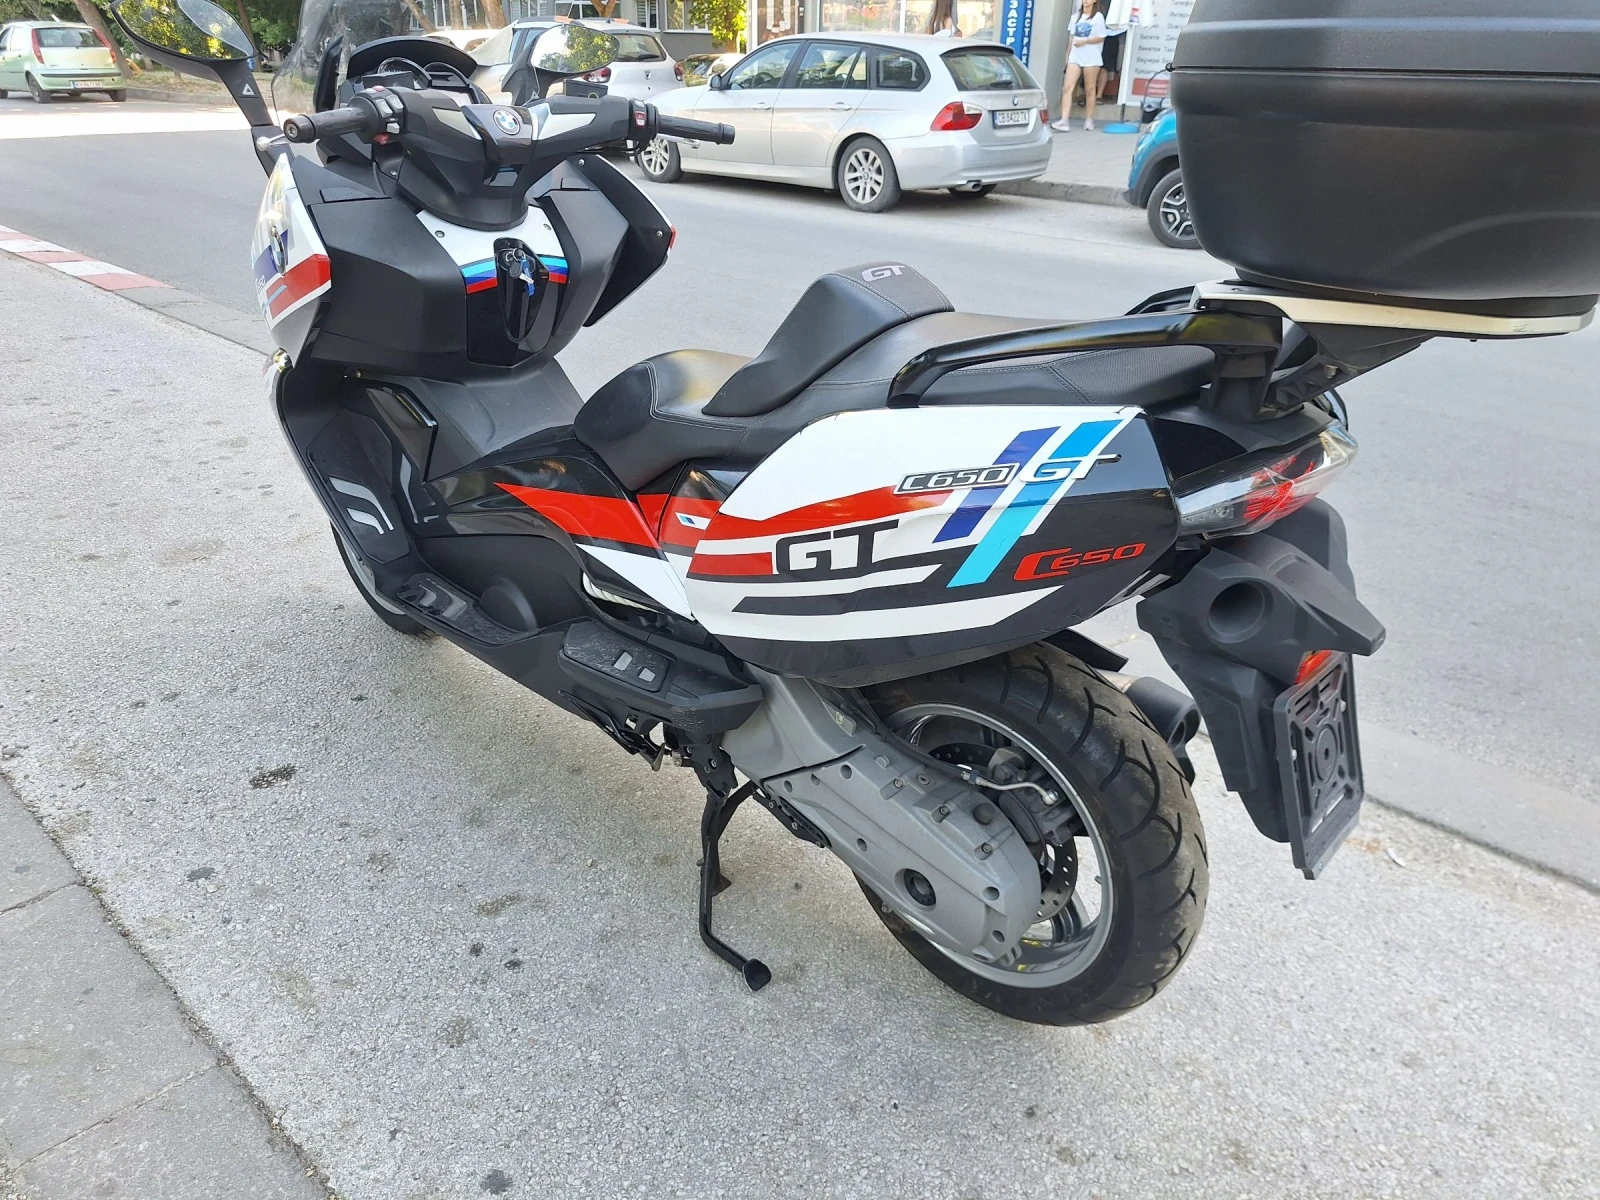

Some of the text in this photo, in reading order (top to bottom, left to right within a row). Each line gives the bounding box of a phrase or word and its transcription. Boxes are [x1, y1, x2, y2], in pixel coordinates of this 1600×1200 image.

[861, 265, 905, 282] GT
[901, 453, 1121, 491] C650 GT
[776, 519, 899, 581] GT
[1013, 542, 1146, 581] C650
